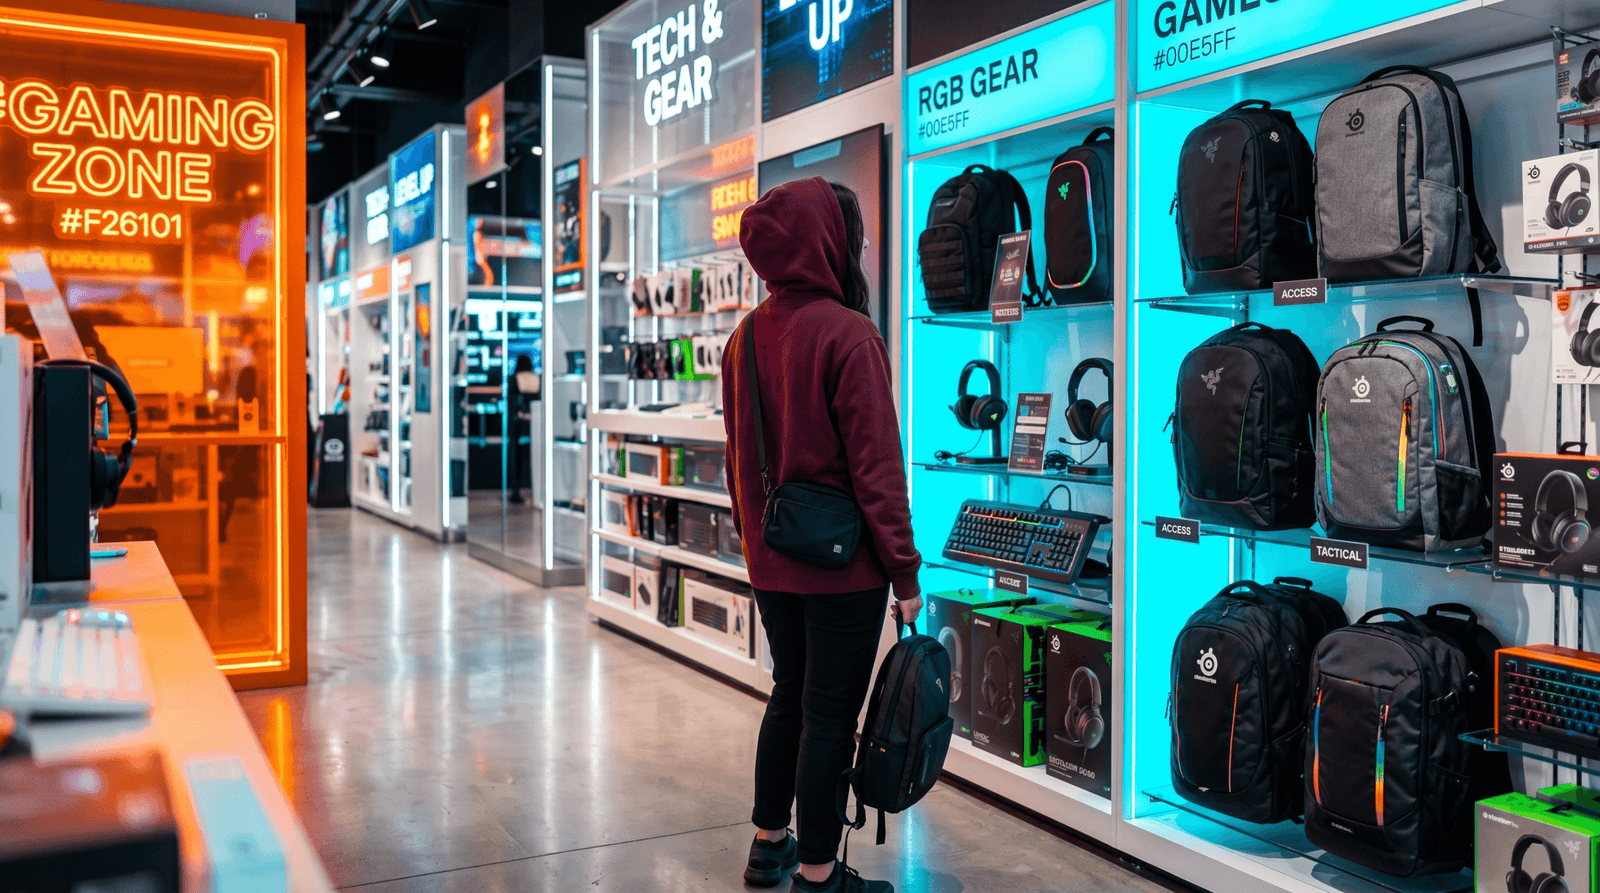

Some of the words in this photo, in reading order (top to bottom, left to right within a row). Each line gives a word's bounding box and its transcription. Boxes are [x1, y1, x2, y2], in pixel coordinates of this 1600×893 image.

[632, 3, 696, 80] TECH
[701, 0, 723, 44] &
[808, 0, 854, 51] UP
[1153, 26, 1236, 71] #00E5FF
[643, 54, 713, 126] GEAR
[919, 74, 963, 116] RGB
[970, 48, 1038, 98] GEAR
[0, 80, 275, 151] GAMING
[918, 110, 970, 140] #00E5FF
[32, 142, 212, 202] ZONE
[60, 208, 181, 239] #F26101
[1281, 286, 1318, 299] ACCESS
[1161, 523, 1191, 536] ACCESS
[1316, 545, 1362, 562] TACTICAL
